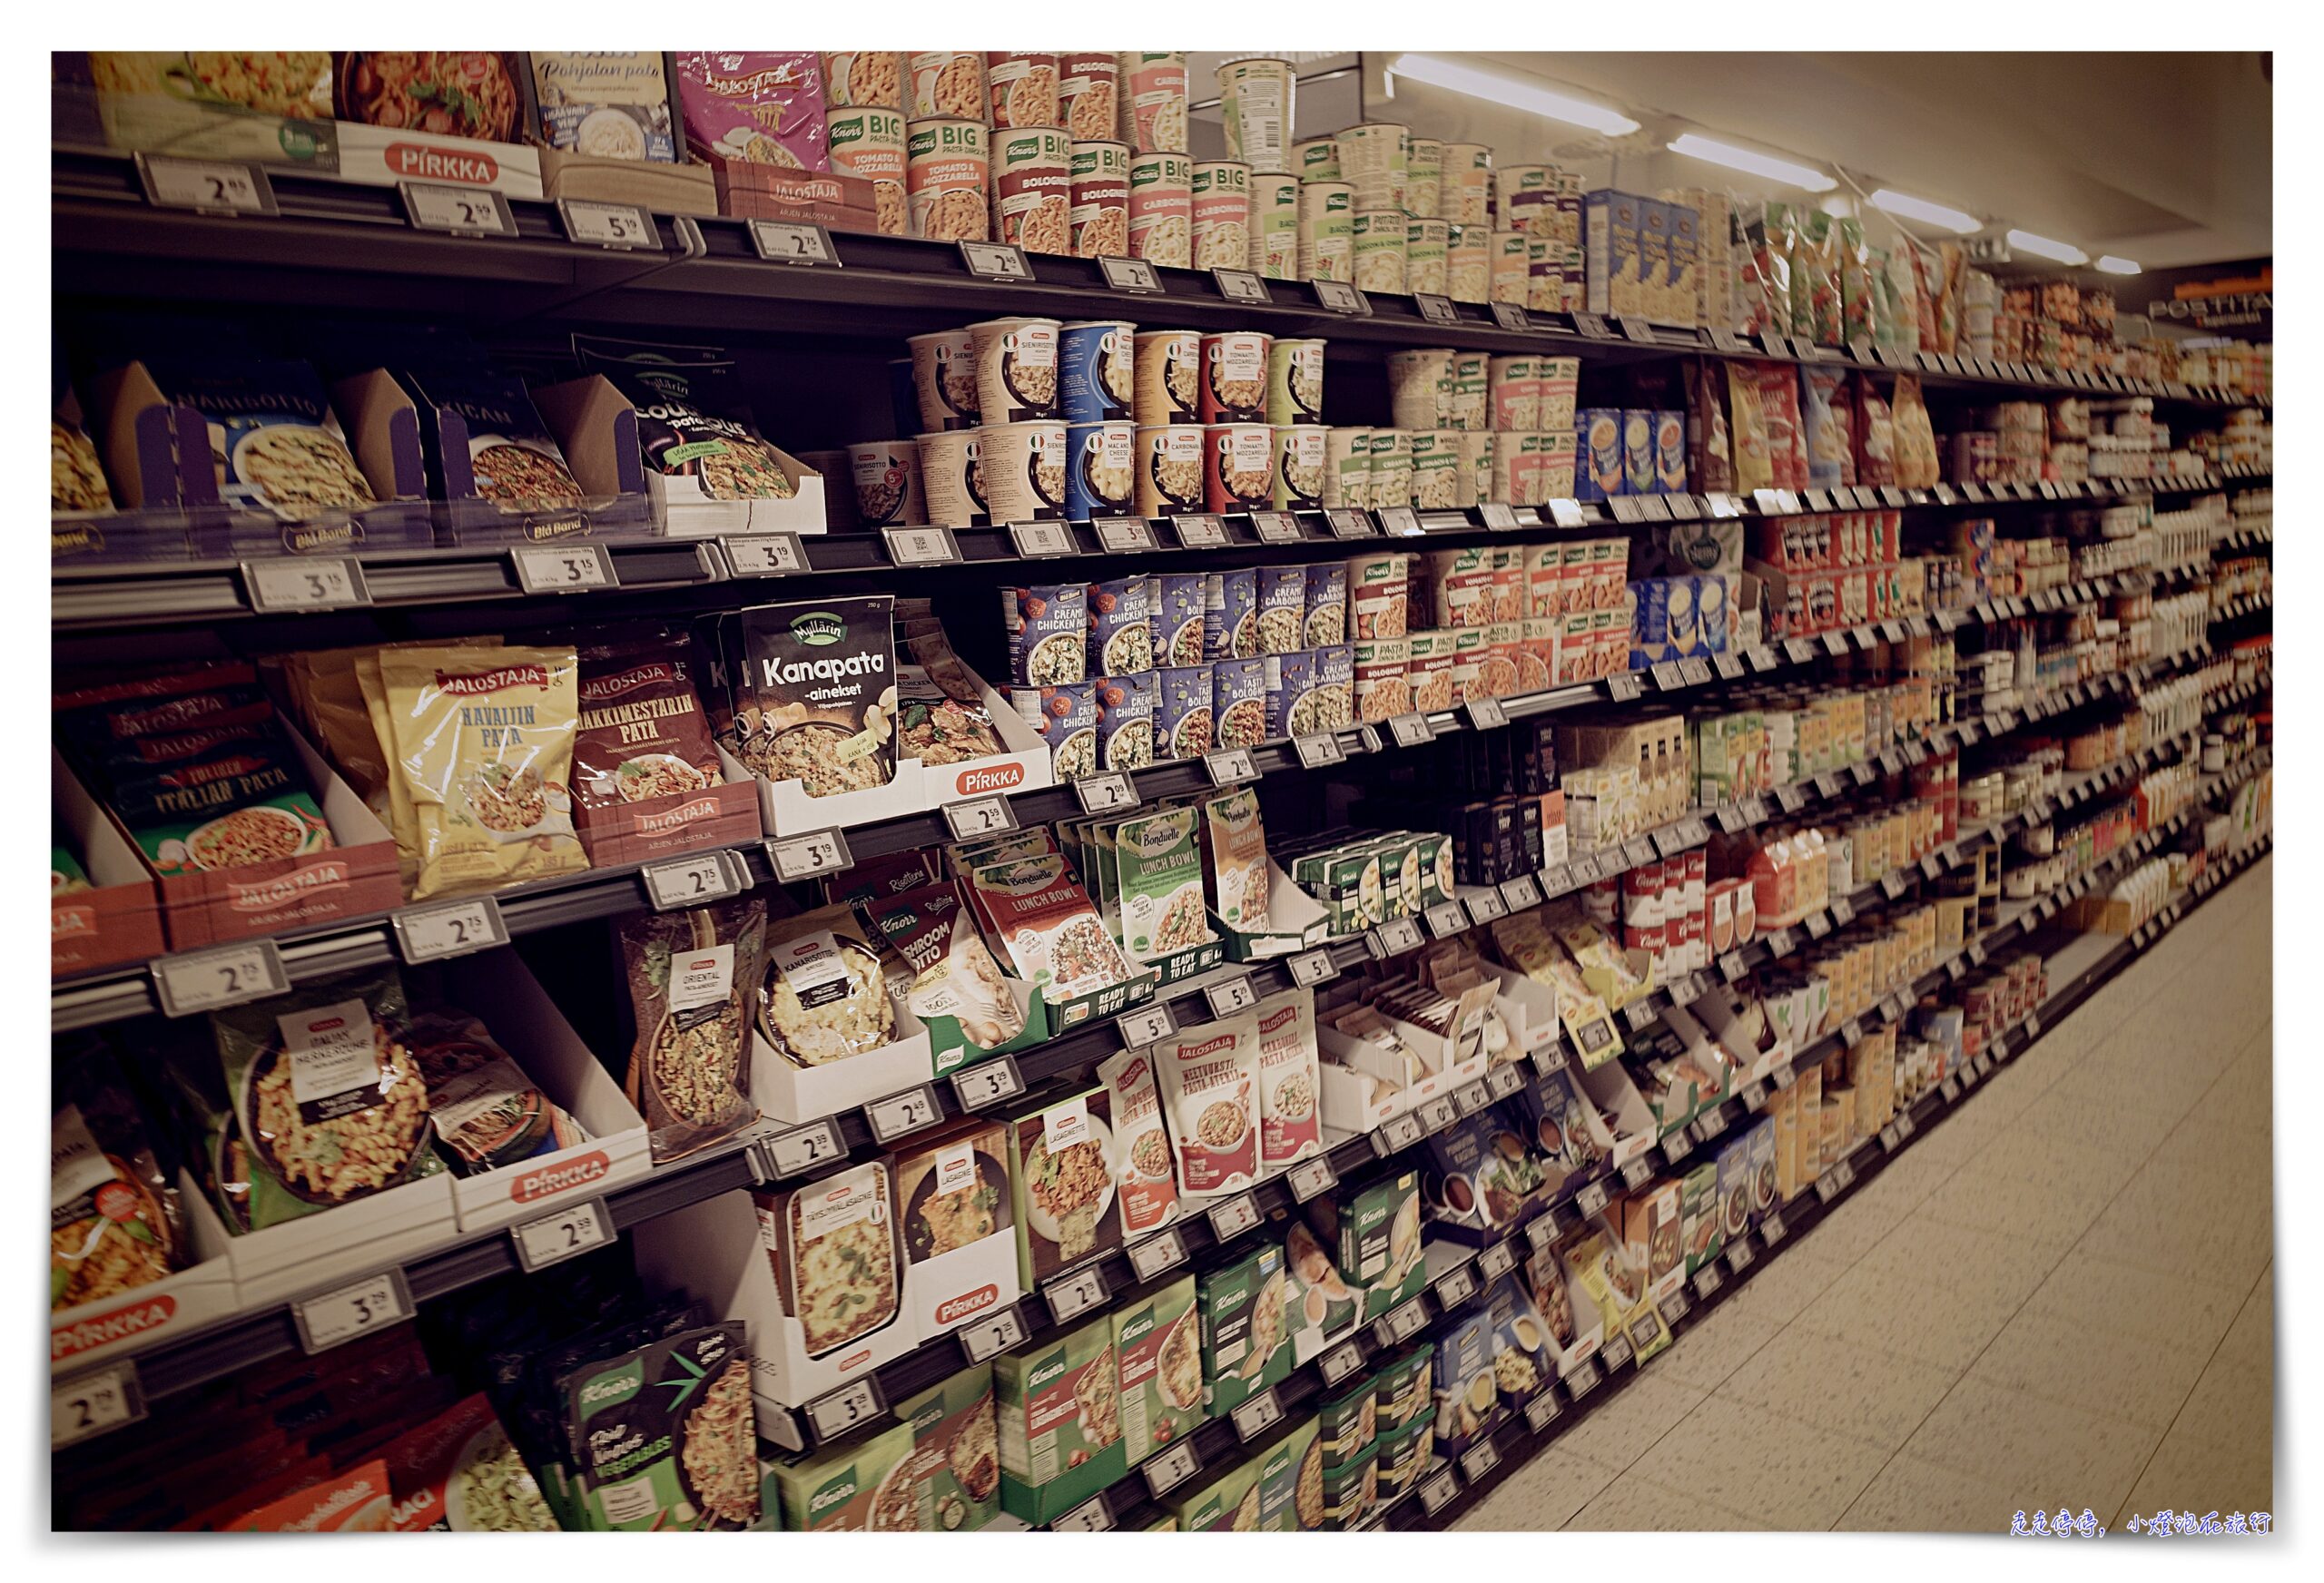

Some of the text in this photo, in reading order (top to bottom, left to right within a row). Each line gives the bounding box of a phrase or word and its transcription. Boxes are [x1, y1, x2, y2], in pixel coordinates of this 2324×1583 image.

[831, 125, 862, 138] Knorr
[943, 127, 976, 145] BIG
[854, 155, 893, 163] TOMATO
[929, 163, 968, 175] TOMATO
[1216, 169, 1244, 184] BIG
[923, 172, 980, 186] MOZZARELLA
[457, 202, 476, 224] 2
[609, 218, 625, 238] 5
[791, 235, 808, 254] 2
[995, 254, 1009, 272] 2
[1128, 269, 1140, 284] 2
[1240, 280, 1252, 296] 2
[553, 516, 582, 535] Band
[1204, 523, 1211, 536] 3
[1282, 519, 1289, 532] 3
[1352, 516, 1359, 527] 3
[1130, 528, 1137, 541] 3
[763, 546, 787, 566] 3 19
[564, 560, 580, 580] 3
[1366, 566, 1389, 577] Knorr
[306, 575, 326, 598] 3
[1038, 620, 1073, 631] CHICKEN
[1109, 612, 1140, 624] CHICKEN
[794, 619, 842, 640] Myllärin
[762, 652, 884, 687] Kanapata
[1368, 667, 1403, 678] BOLOGNESE
[445, 669, 540, 693] JALOSTAJA
[586, 667, 665, 695] JALOSTAJA
[804, 683, 862, 702] -ainekset
[462, 705, 536, 725] HAVAIJIN
[1116, 707, 1148, 717] CHICKEN
[1063, 716, 1093, 728] CHICKEN
[1410, 723, 1419, 739] 2
[480, 728, 522, 748] PATA
[619, 721, 659, 743] PATA
[1321, 742, 1330, 757] 2
[1235, 759, 1248, 776] 2 09
[237, 766, 290, 795] PATA
[1106, 783, 1125, 803] 2 09
[641, 801, 716, 833] JALOSTAJA
[979, 808, 999, 829] 2 59
[1143, 829, 1179, 847] Bonduelle
[808, 844, 832, 866] 3 19
[1139, 850, 1196, 875] LUNCH BOWL
[689, 869, 716, 893] 2 75
[1009, 871, 1053, 887] Bonduelle
[1011, 888, 1078, 912] LUNCH BOWL
[1487, 900, 1494, 914] 2
[880, 915, 918, 933] Knorr
[1444, 913, 1452, 927] 2
[1448, 913, 1454, 928] 2
[448, 916, 482, 944] 2 75
[1402, 929, 1410, 942] 2
[1170, 952, 1196, 968] READY
[1315, 960, 1323, 977] 5
[218, 967, 241, 992] 2
[1170, 963, 1196, 978] TO EAT
[1098, 987, 1126, 1005] READY
[1235, 988, 1243, 1006] 5
[1098, 1000, 1124, 1016] TO EAT
[1151, 1018, 1159, 1037] 5
[1181, 1037, 1232, 1058] JALOSTAJA
[986, 1075, 1000, 1094] 3
[901, 1105, 917, 1125] 2
[803, 1139, 819, 1160] 2
[940, 1169, 972, 1185] LASAGNE
[1360, 1204, 1387, 1228] Knorr
[561, 1223, 581, 1247] 2
[1076, 1287, 1088, 1305] 2
[1216, 1289, 1247, 1313] Knorr
[352, 1297, 371, 1324] 3
[991, 1327, 1005, 1346] 2
[1120, 1318, 1155, 1343] Knorr
[1344, 1354, 1352, 1367] 2
[1028, 1362, 1067, 1388] Knorr
[582, 1377, 641, 1404] Knorr
[68, 1399, 96, 1429] 2
[846, 1398, 858, 1420] 3
[1258, 1411, 1265, 1423] 2
[810, 1482, 856, 1514] Knorr
